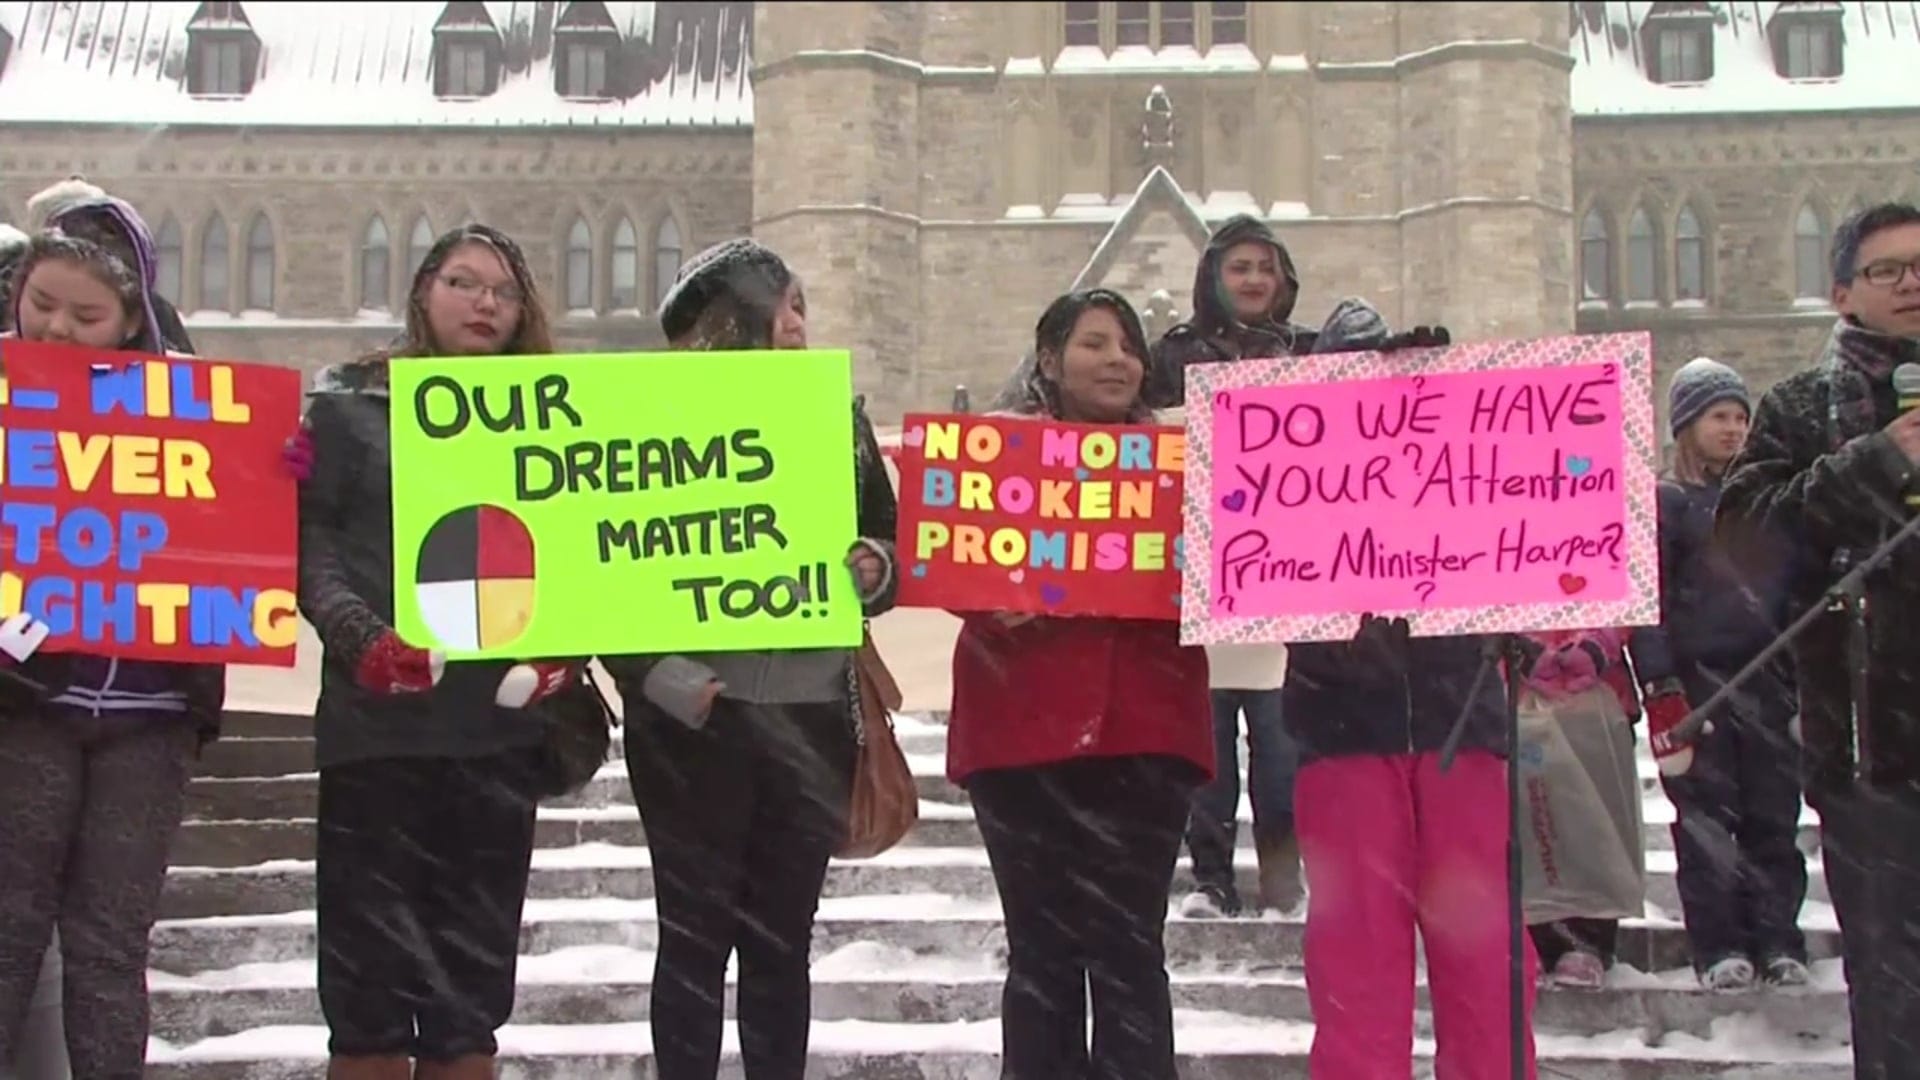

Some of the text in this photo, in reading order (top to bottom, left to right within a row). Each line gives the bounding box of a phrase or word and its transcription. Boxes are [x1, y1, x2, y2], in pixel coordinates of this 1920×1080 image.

[90, 360, 250, 423] WILL
[414, 374, 582, 439] OUR
[1238, 378, 1615, 453] DO WE HAVE
[0, 425, 216, 499] EVER
[514, 428, 774, 501] DREAMS
[924, 422, 1184, 472] NO MORE
[1235, 442, 1615, 516] YOUR Attention
[922, 467, 1153, 519] BROKEN
[597, 503, 788, 563] MATTER
[1222, 519, 1624, 593] Prime Minister Harper?
[0, 571, 297, 648] IGHTING
[673, 562, 829, 623] TOO!!
